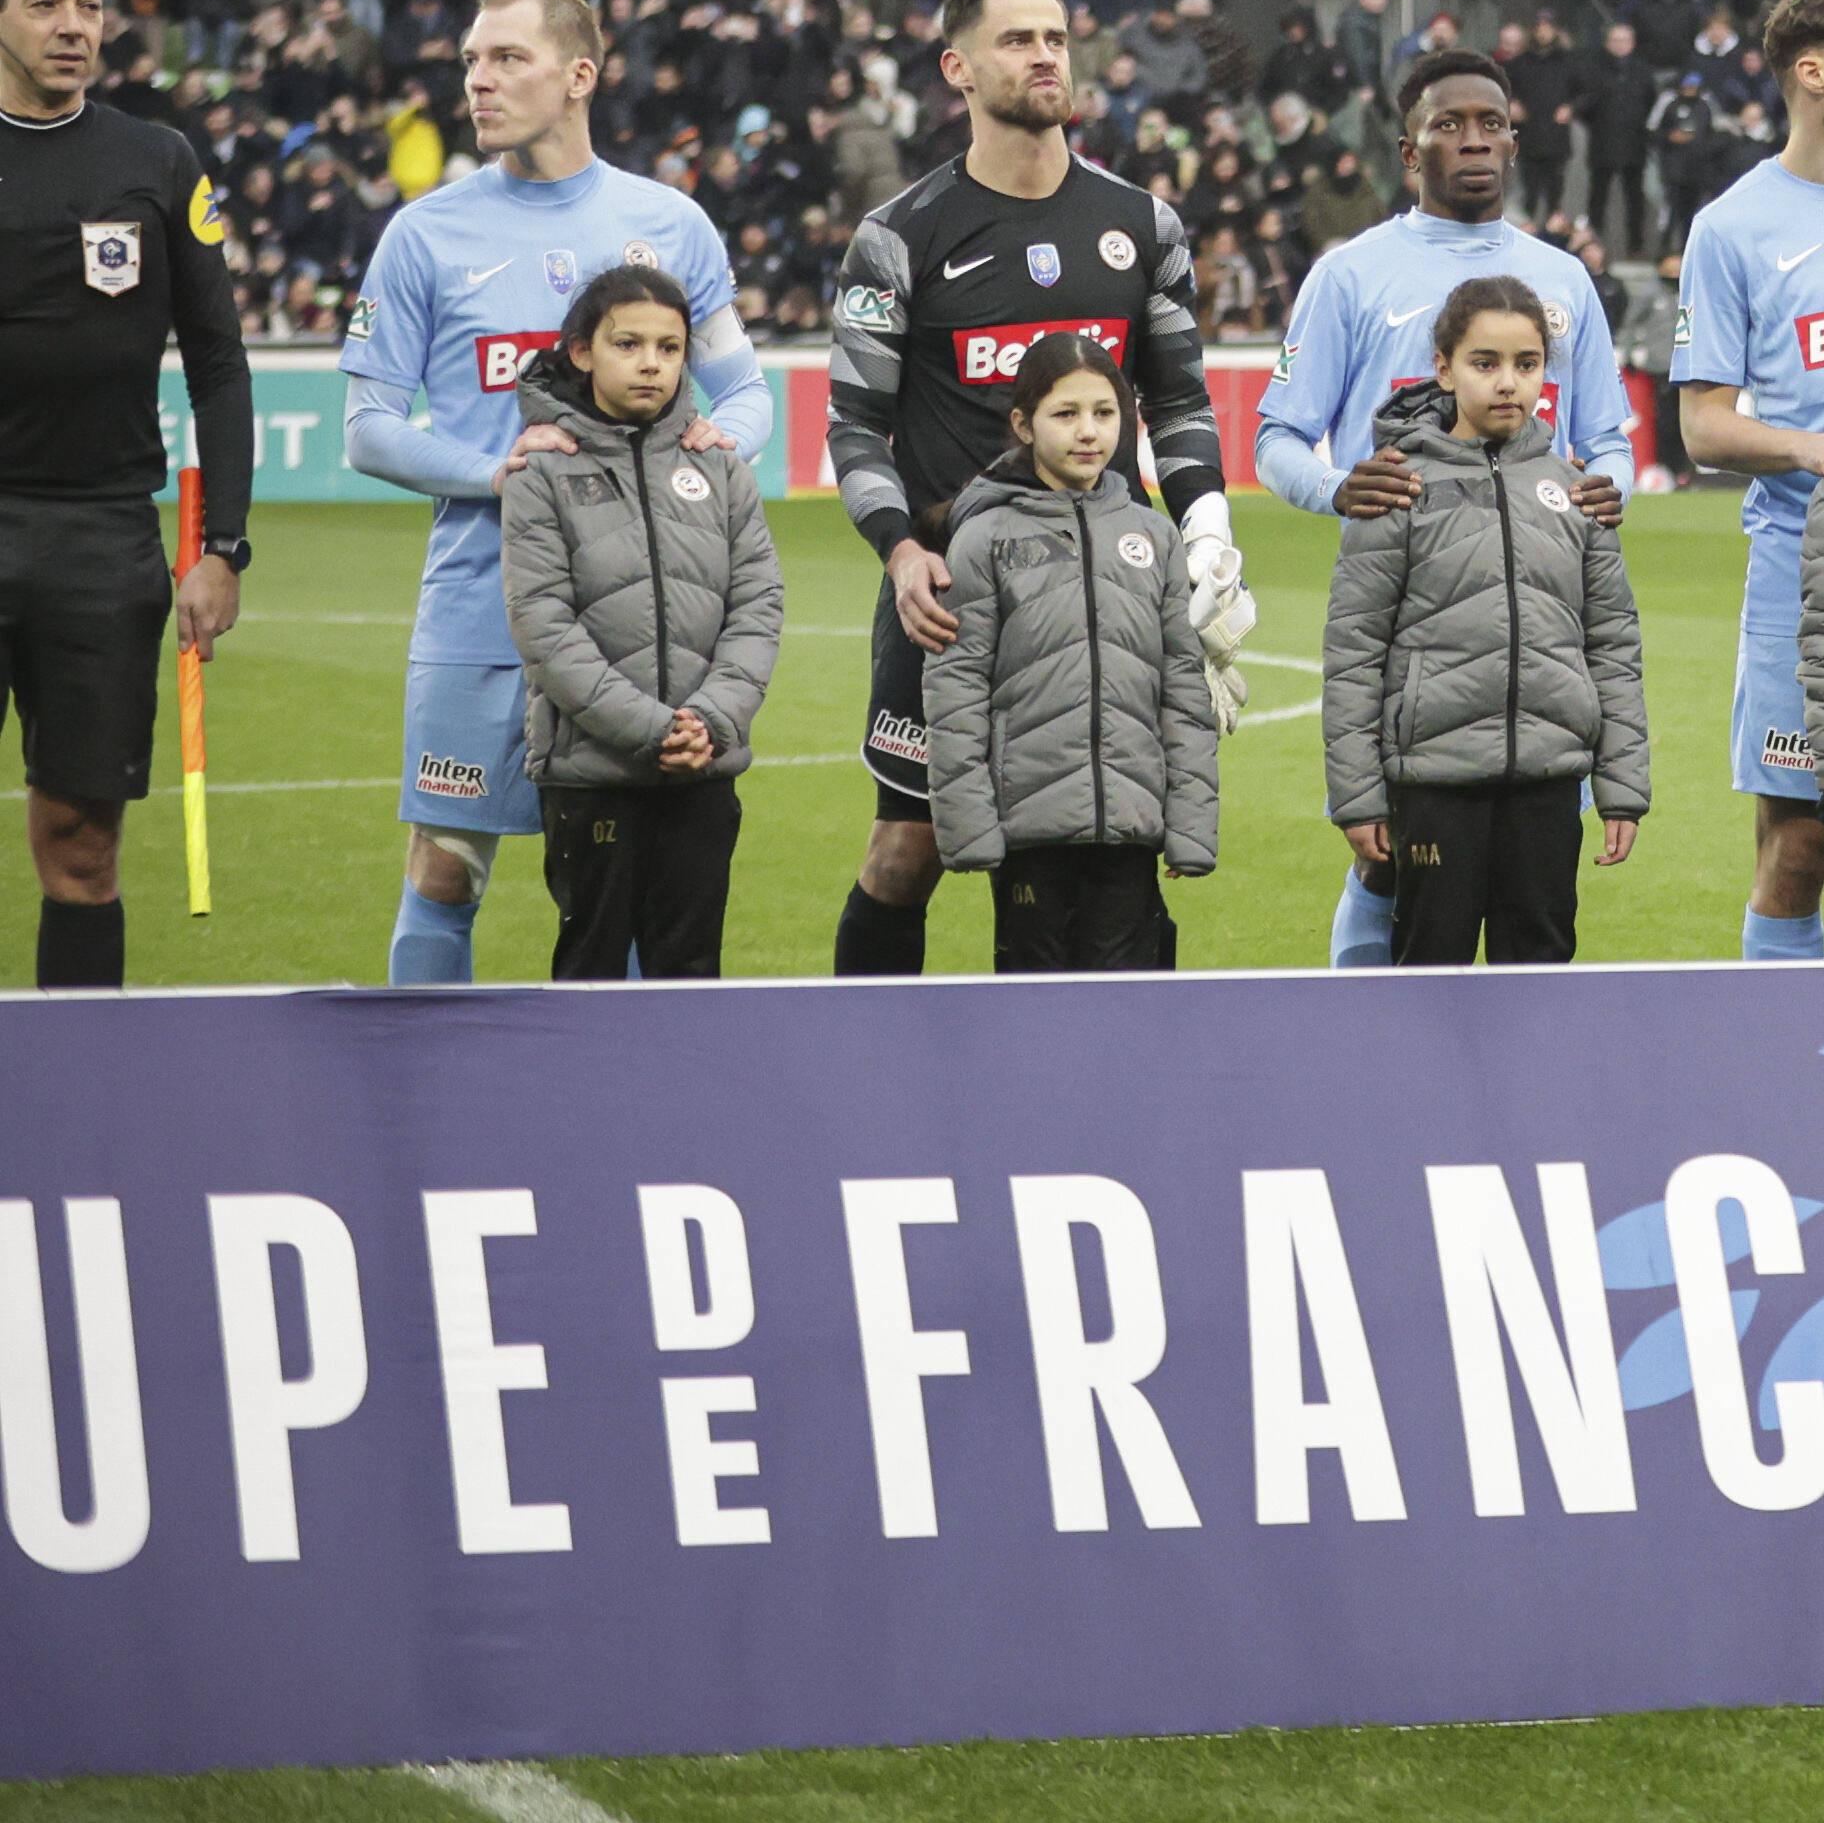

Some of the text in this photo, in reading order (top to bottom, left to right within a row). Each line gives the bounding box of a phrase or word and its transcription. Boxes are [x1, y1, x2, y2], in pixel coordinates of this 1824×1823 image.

[1765, 730, 1811, 754] Inte
[1763, 753, 1814, 770] march
[1411, 843, 1441, 866] MA
[0, 1188, 573, 1574] UPE
